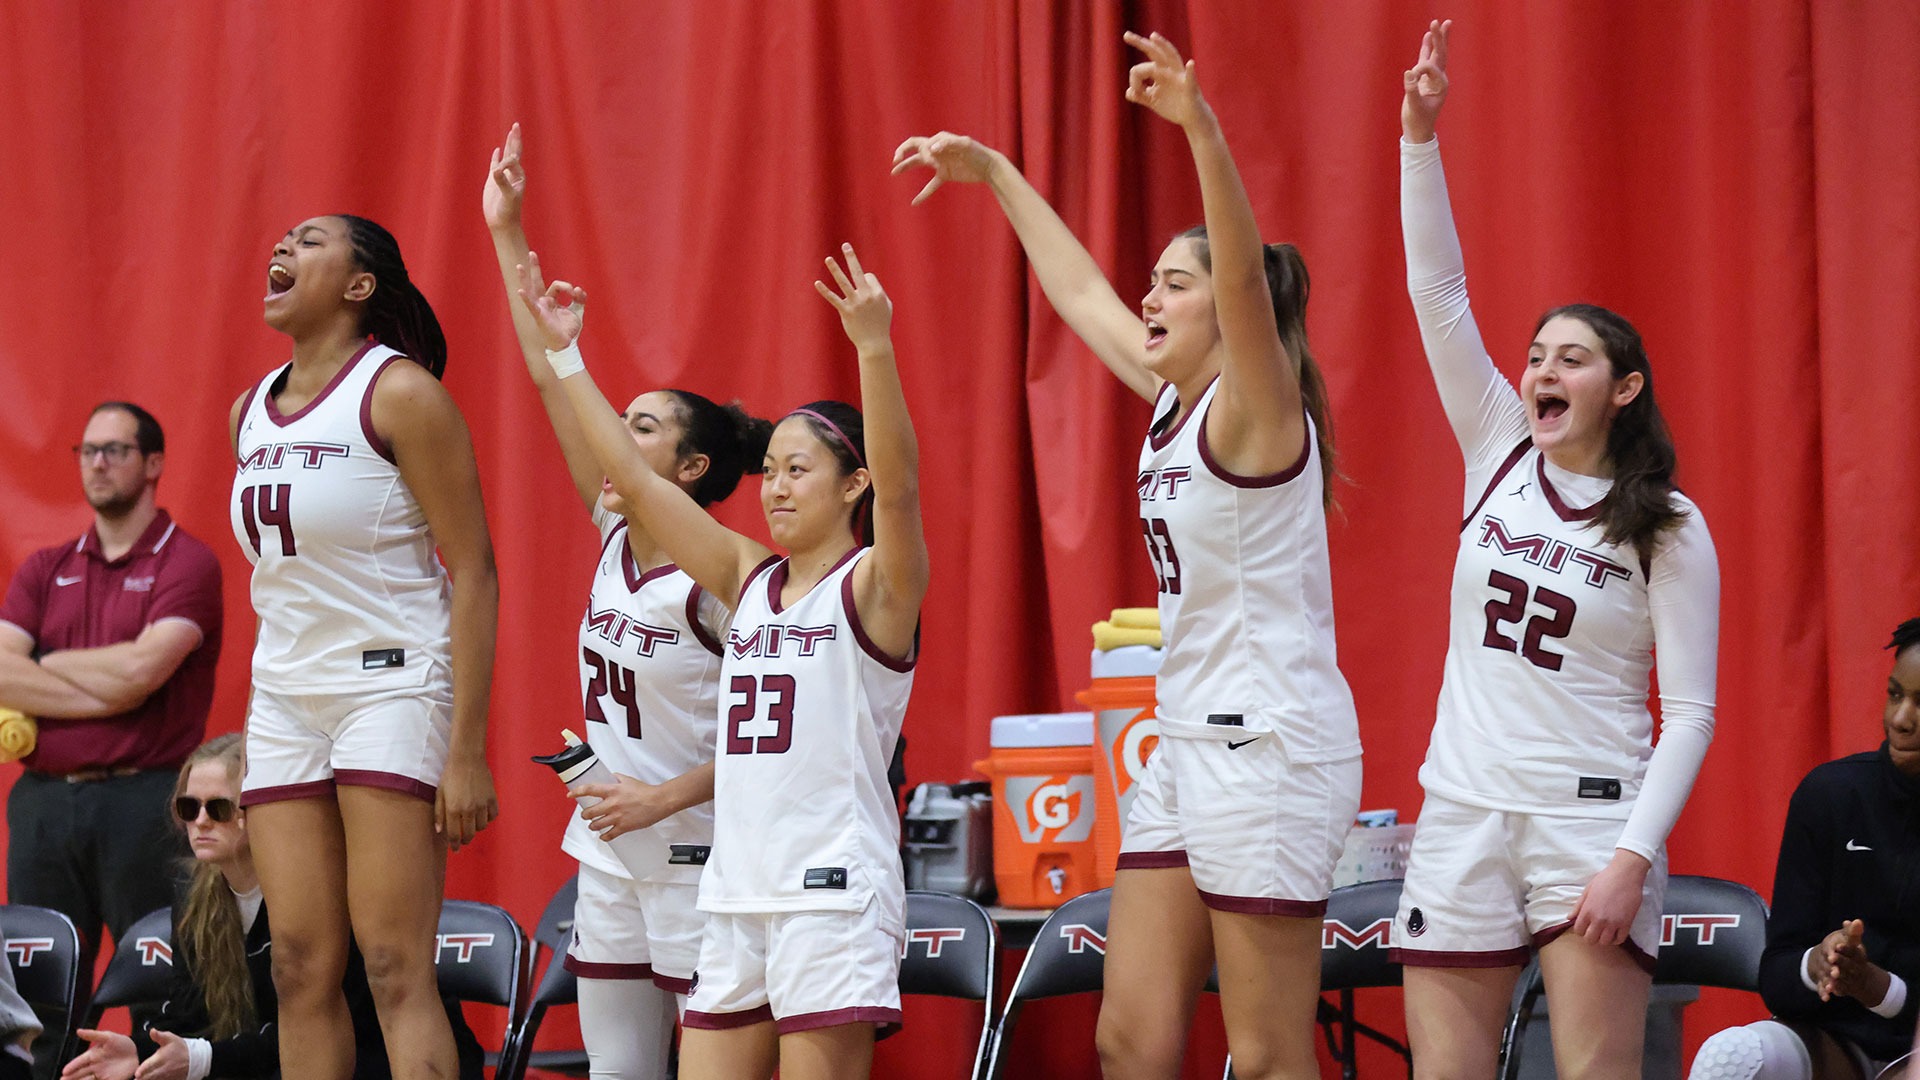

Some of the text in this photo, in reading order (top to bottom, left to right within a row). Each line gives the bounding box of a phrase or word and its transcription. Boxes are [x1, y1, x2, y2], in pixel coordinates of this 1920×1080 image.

[240, 483, 297, 557] 14
[1478, 514, 1633, 589] MIT
[728, 624, 837, 660] MIT
[1483, 569, 1577, 672] 22
[392, 653, 398, 662] L
[583, 645, 642, 739] 24
[726, 673, 796, 755] 23
[1032, 784, 1069, 829] G
[832, 873, 842, 882] M
[1659, 914, 1741, 946] IT
